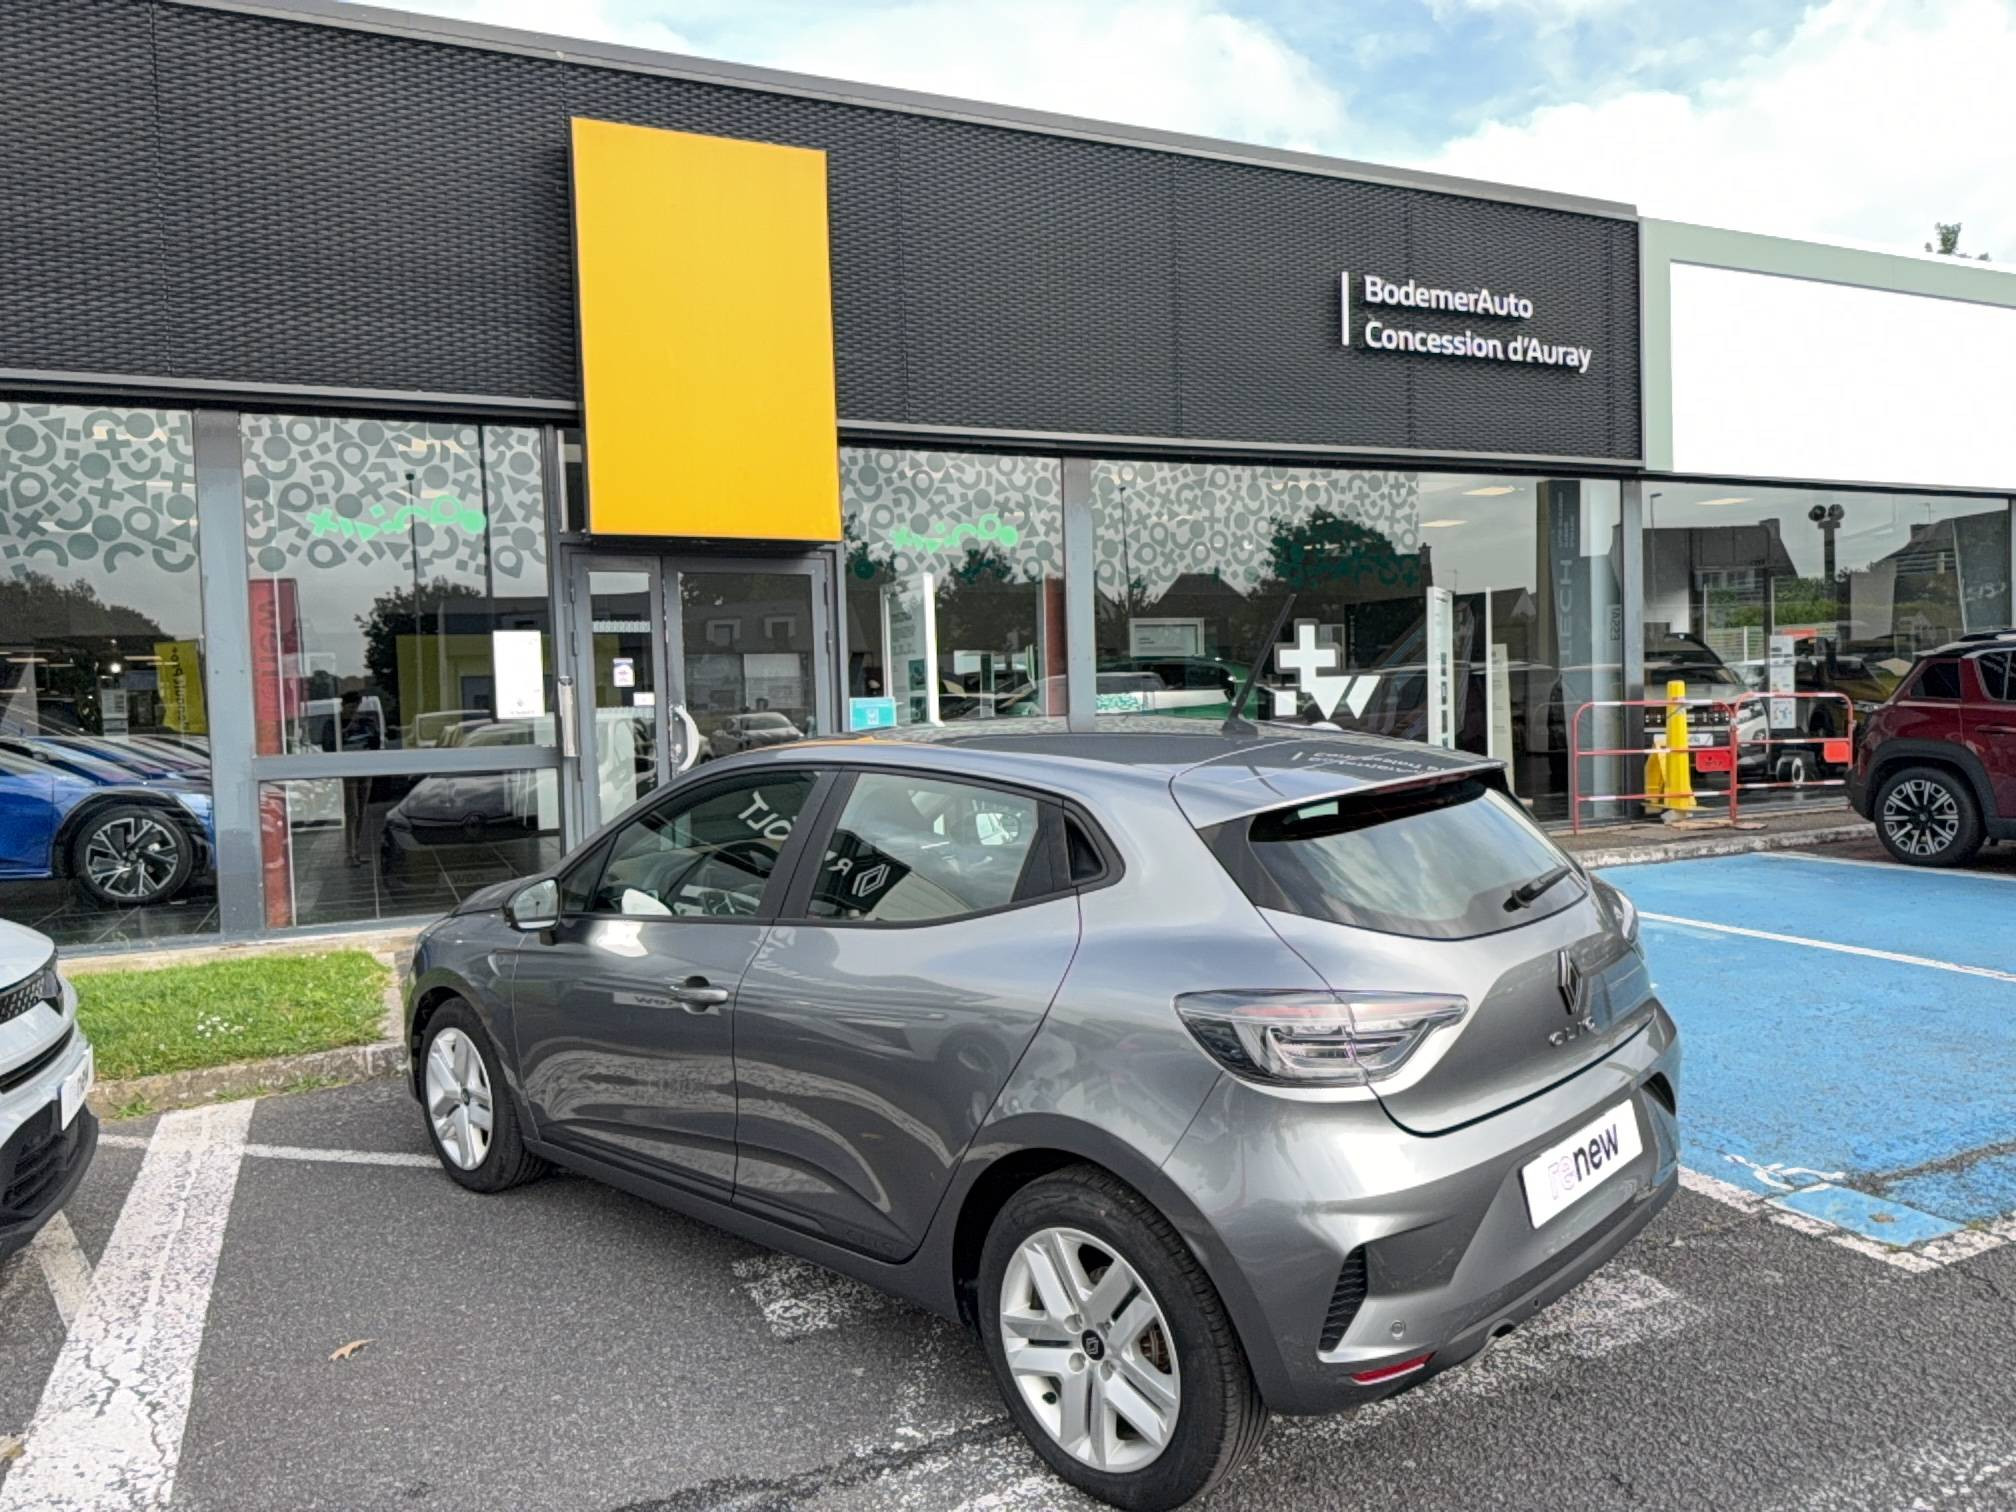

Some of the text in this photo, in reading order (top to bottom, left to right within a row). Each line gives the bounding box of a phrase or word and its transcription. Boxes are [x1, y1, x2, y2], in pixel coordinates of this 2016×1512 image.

[1364, 275, 1534, 320] BodemerAuto
[1364, 321, 1592, 374] Concession d'Auray
[1547, 1123, 1619, 1201] renew
